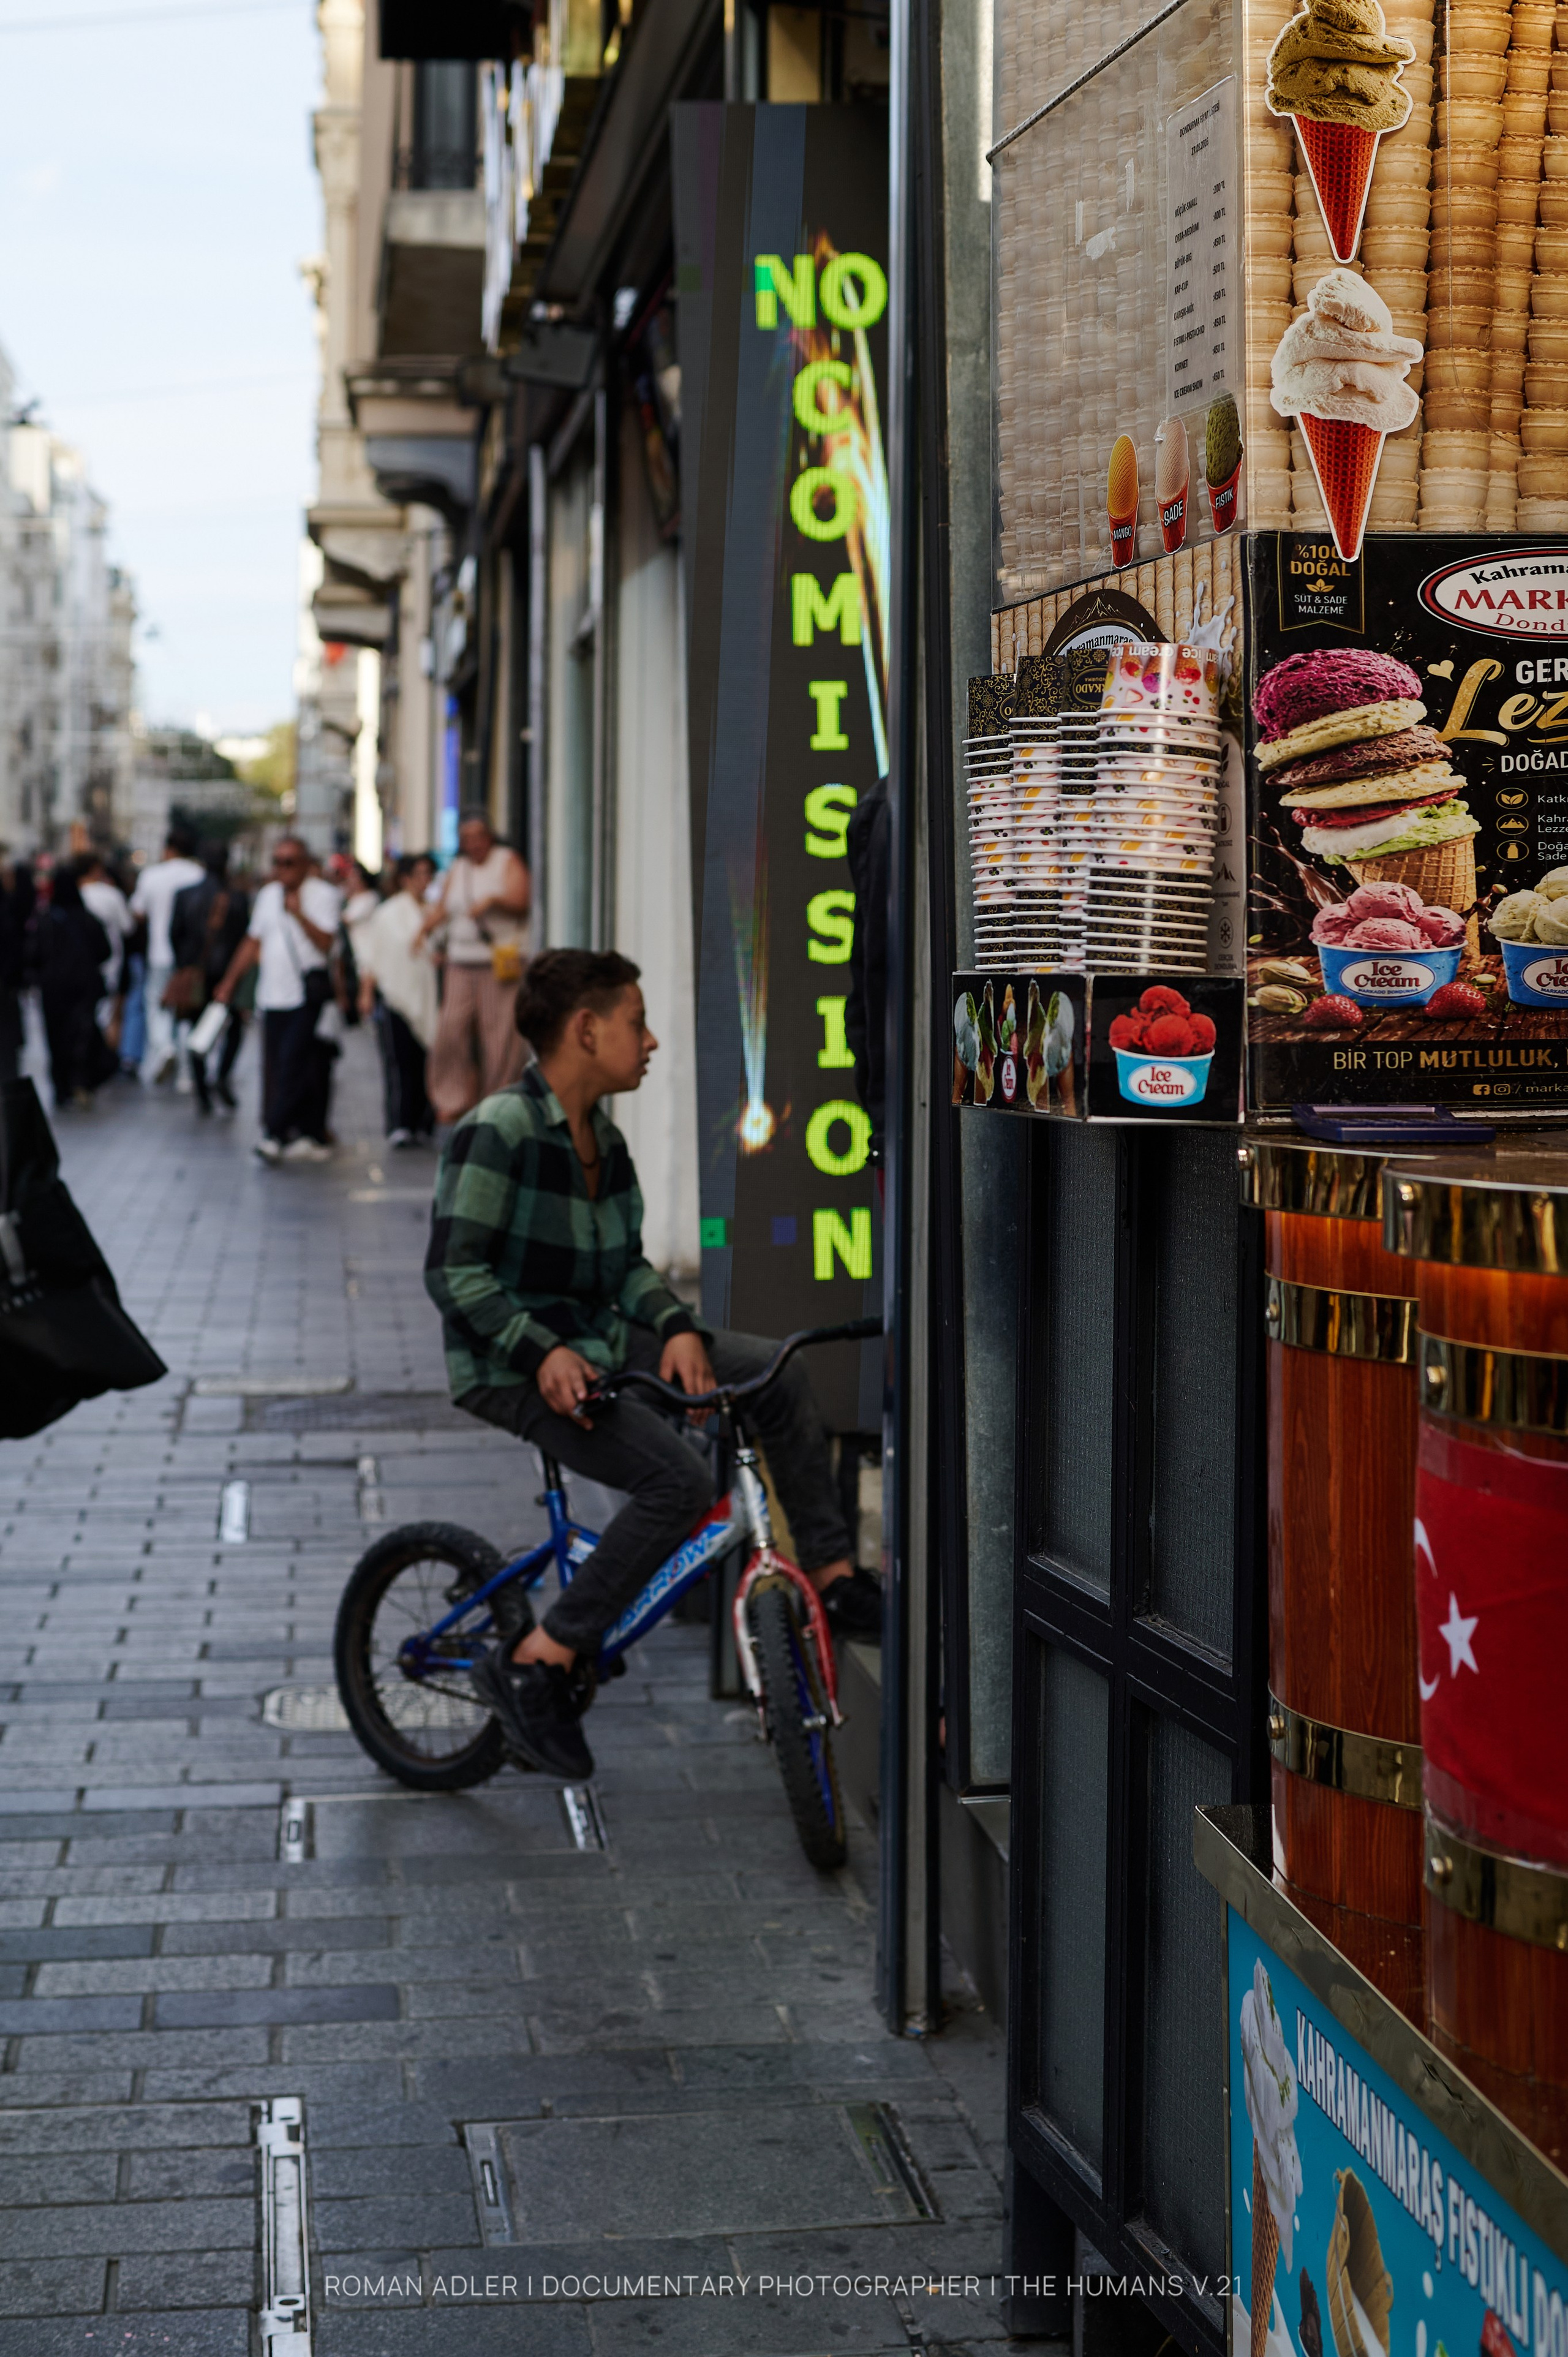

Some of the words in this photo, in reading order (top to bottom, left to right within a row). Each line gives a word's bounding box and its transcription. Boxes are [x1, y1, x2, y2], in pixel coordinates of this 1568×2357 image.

[755, 252, 888, 331] NO
[1164, 500, 1183, 526] SADE
[1113, 526, 1132, 541] MANGO
[1291, 559, 1351, 576] DOĞAL
[1294, 593, 1312, 603] SÜT
[1298, 605, 1344, 614] MALZEME
[1537, 851, 1567, 861] Sade
[1371, 962, 1402, 976] Ice
[1354, 974, 1421, 987] Cream
[1333, 1049, 1366, 1069] BİR
[1373, 1051, 1413, 1069] TOP
[1419, 1049, 1558, 1068] MUTLULUK,
[1151, 1066, 1171, 1082] Ice
[1138, 1079, 1185, 1095] Cream
[1295, 2005, 1444, 2273] KAHRAMANMARAŞ
[1447, 2173, 1529, 2351] FISTIKLI
